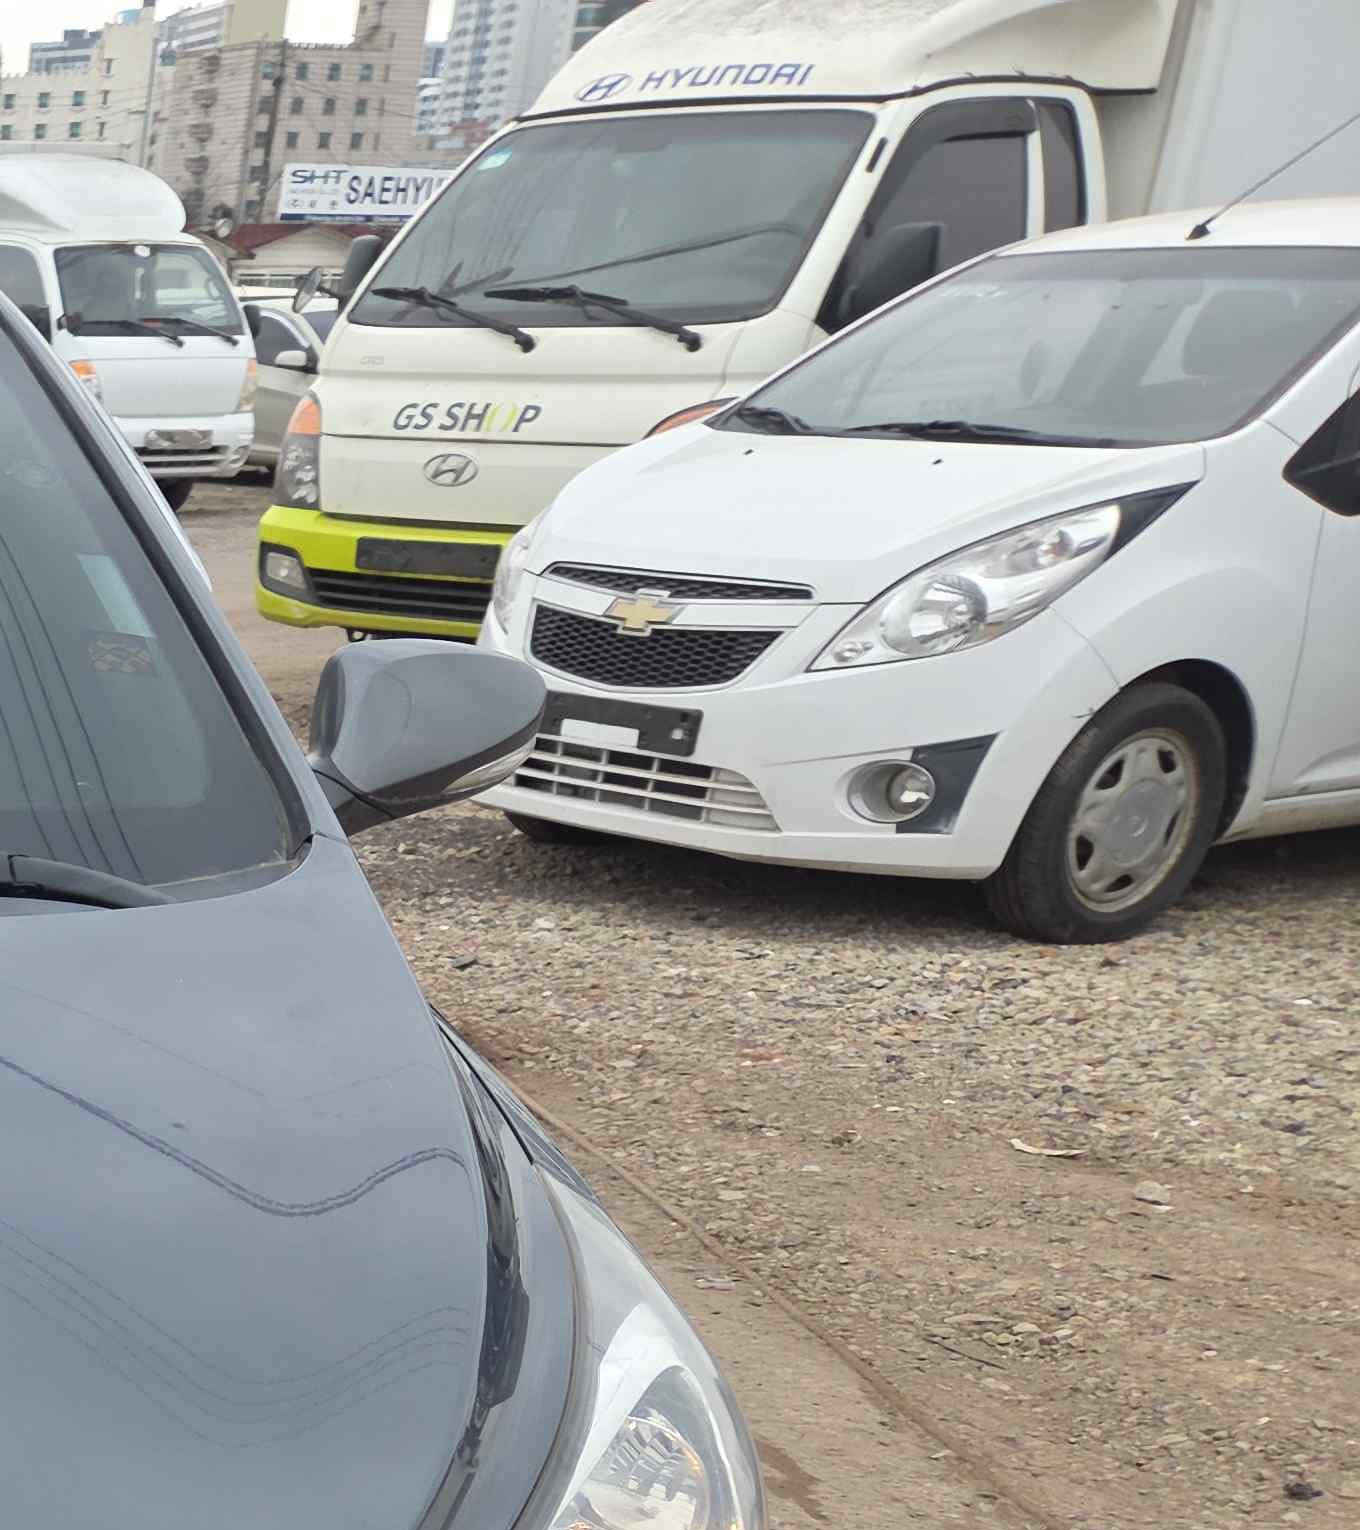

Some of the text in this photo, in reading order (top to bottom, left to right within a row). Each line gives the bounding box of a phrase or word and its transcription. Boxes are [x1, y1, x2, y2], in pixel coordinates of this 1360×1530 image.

[638, 63, 817, 92] HYUNDAI
[290, 169, 348, 185] SHT
[392, 402, 440, 431] GS
